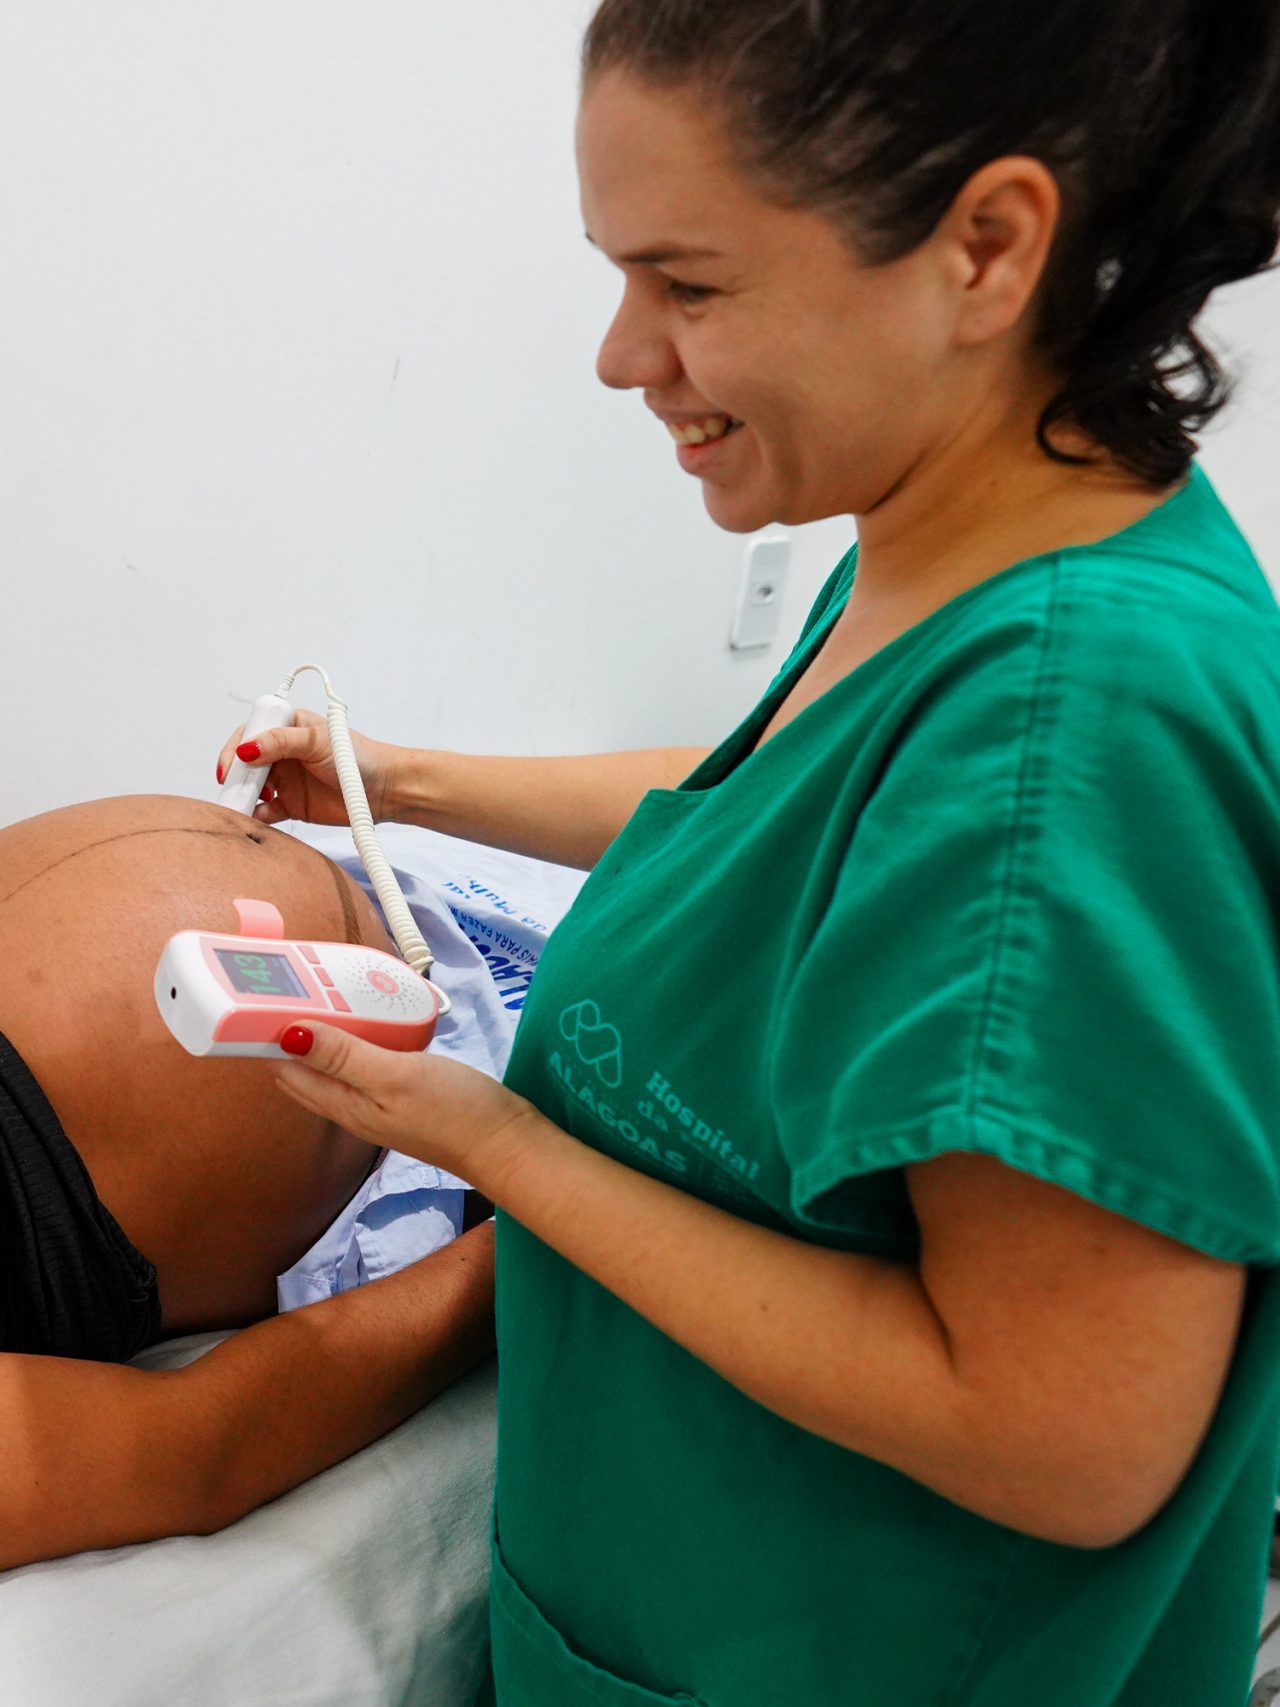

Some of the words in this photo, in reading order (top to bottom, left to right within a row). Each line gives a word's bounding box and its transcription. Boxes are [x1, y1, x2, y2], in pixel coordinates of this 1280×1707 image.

[460, 911, 493, 939] FAZER
[496, 930, 523, 957] PARA
[233, 954, 282, 993] 143
[549, 1051, 687, 1173] ALAGOAS
[637, 1099, 669, 1133] da
[646, 1070, 760, 1181] Hospital
